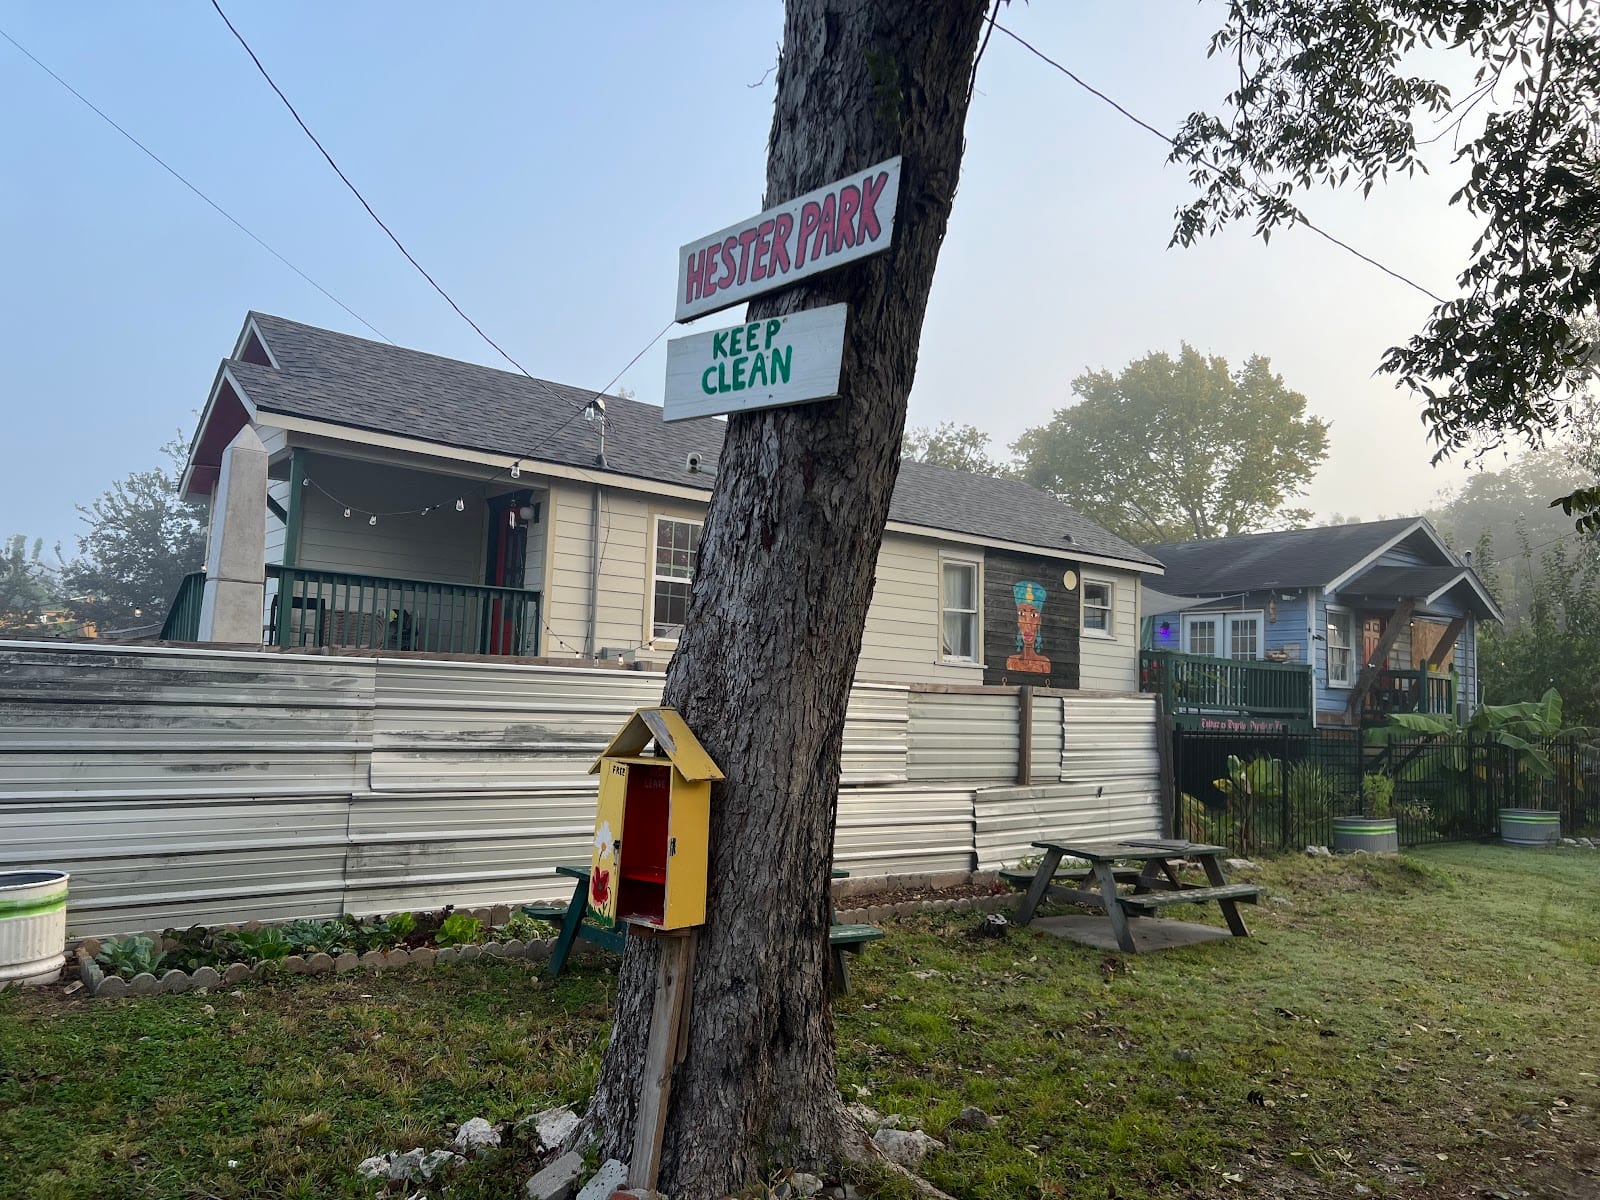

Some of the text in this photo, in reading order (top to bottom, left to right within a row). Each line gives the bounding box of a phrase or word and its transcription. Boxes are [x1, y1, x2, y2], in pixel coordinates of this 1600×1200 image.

[686, 171, 889, 304] HESTER PARK
[713, 319, 781, 360] KEEP
[702, 345, 792, 394] CLEAN
[612, 766, 625, 777] FREE
